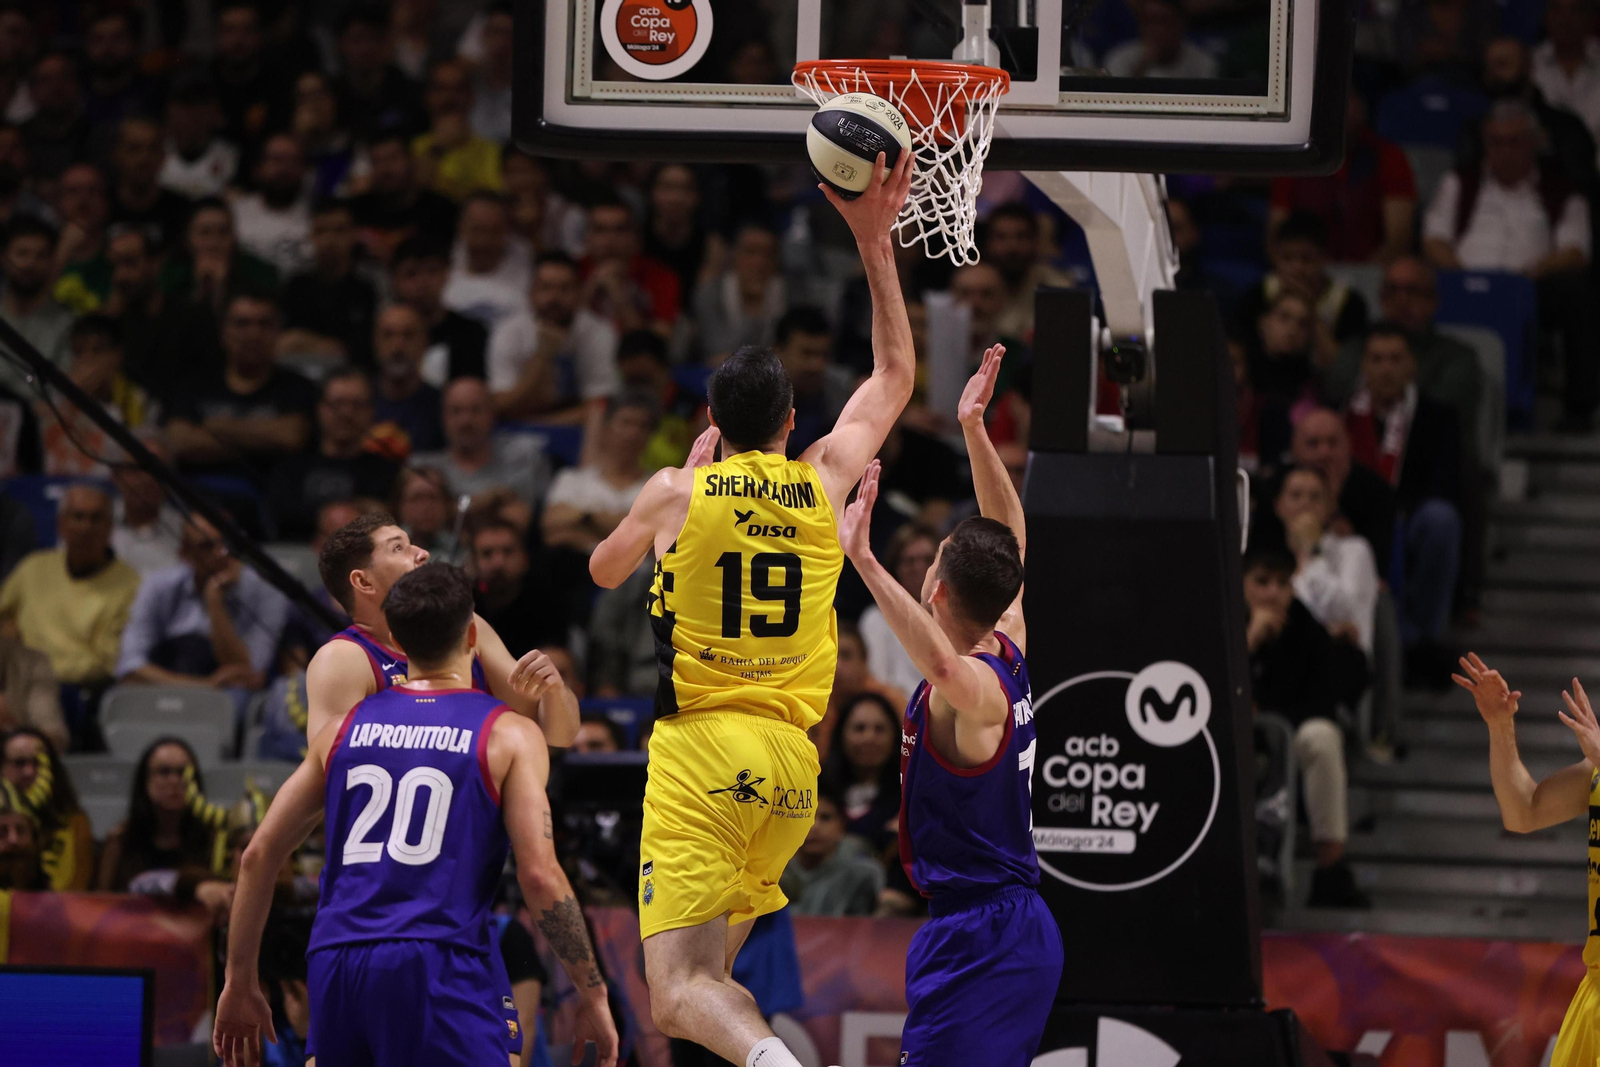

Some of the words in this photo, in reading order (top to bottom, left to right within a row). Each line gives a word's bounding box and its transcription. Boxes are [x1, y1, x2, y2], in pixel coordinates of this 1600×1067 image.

[630, 15, 671, 29] Copa
[639, 7, 660, 16] acb
[649, 30, 676, 44] Rey
[886, 109, 904, 131] 2024
[704, 474, 816, 509] SHERMADINI
[715, 551, 803, 638] 19
[758, 657, 777, 666] DEL
[780, 653, 808, 665] DUQUE
[349, 723, 473, 754] LAPROVITTOLA
[1064, 733, 1120, 757] acb
[1042, 755, 1146, 794] Copa
[342, 764, 454, 866] 20
[1047, 792, 1085, 812] del
[1091, 794, 1160, 834] Rey
